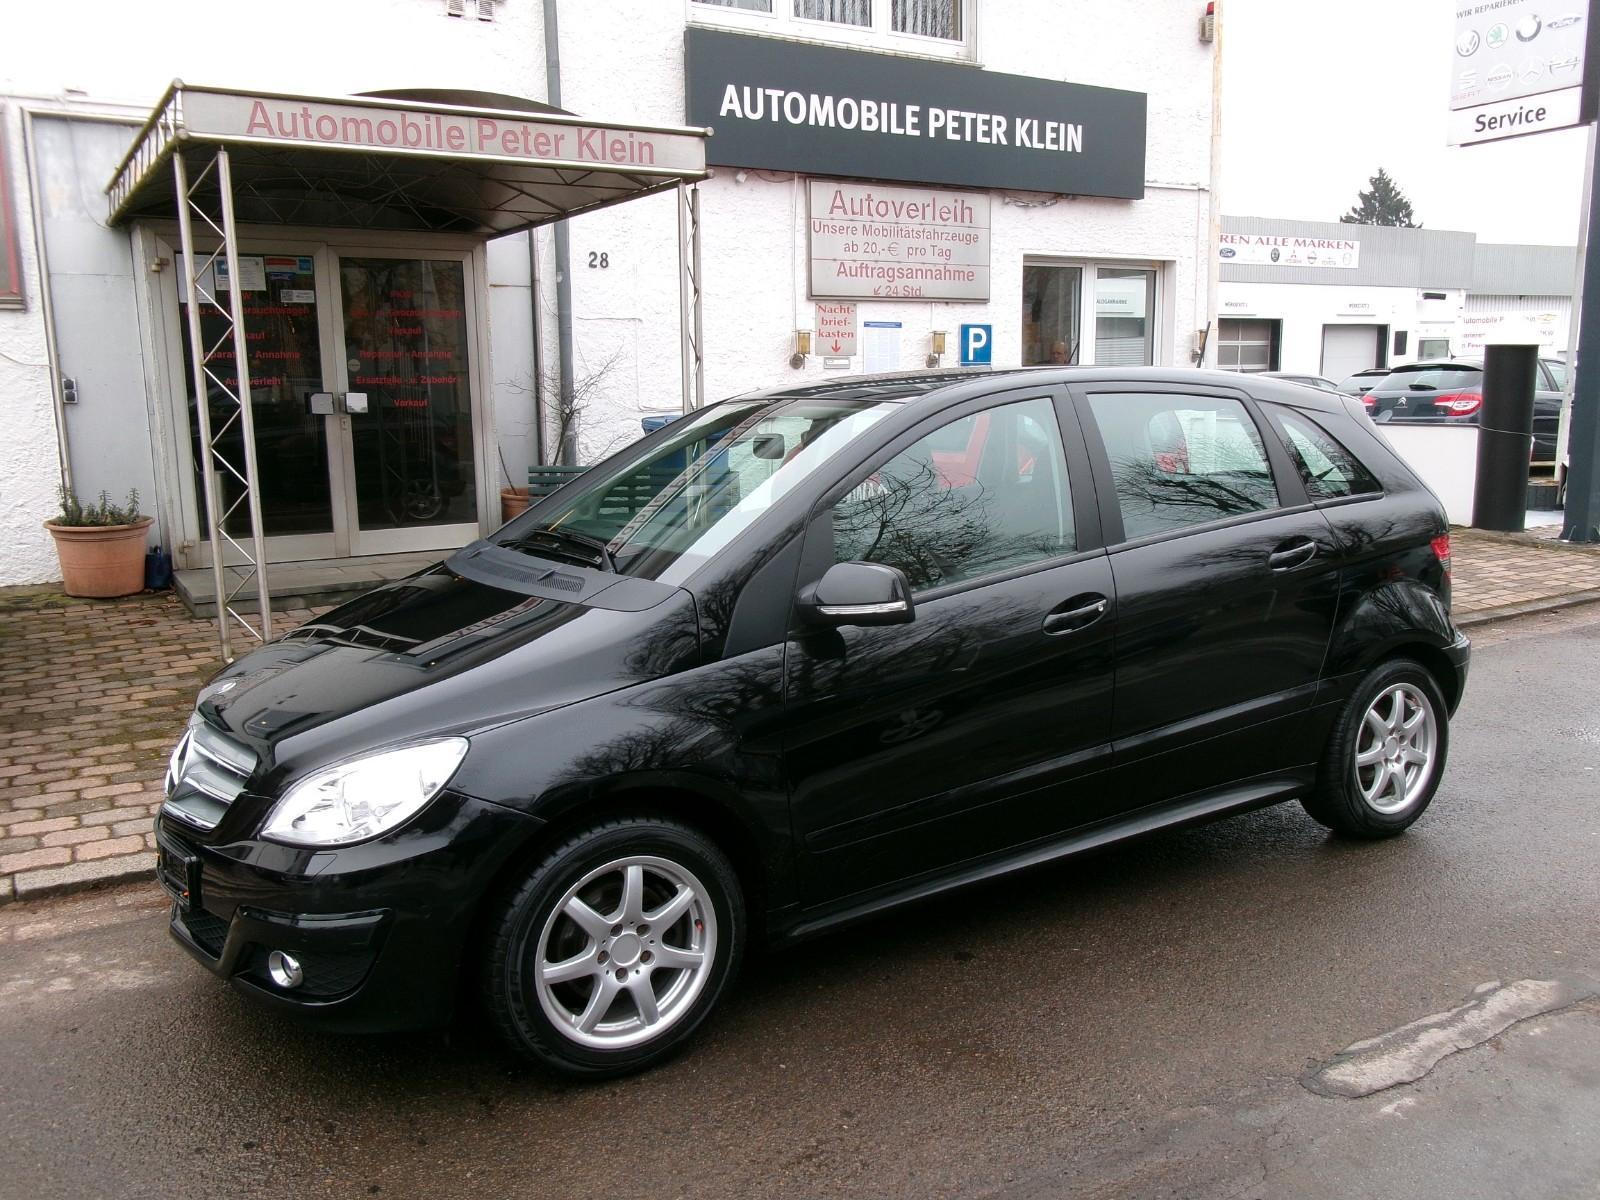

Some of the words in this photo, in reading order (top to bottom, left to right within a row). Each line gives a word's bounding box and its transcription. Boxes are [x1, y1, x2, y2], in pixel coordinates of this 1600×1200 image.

[719, 84, 921, 137] AUTOMOBILE
[928, 107, 1008, 146] PETER
[1015, 117, 1083, 153] KLEIN
[1474, 106, 1547, 132] Service
[246, 100, 465, 150] Automobile
[477, 119, 565, 157] Peter
[577, 127, 655, 165] Klein
[829, 190, 974, 224] Autoverleih
[813, 220, 858, 236] Unsere
[862, 224, 979, 246] Mobilitätsfahrzeuge
[843, 241, 859, 253] ab
[907, 245, 927, 259] pro
[930, 245, 952, 261] Tag
[1255, 237, 1289, 247] ALLE
[1293, 239, 1355, 250] MARKEN
[588, 251, 609, 269] 28
[836, 261, 975, 283] Auftragsannahme
[885, 286, 900, 297] 24
[902, 285, 925, 298] Std.
[817, 304, 854, 314] Nacht-
[821, 316, 852, 327] brief-
[817, 329, 854, 339] kasten
[968, 327, 987, 361] P
[394, 399, 428, 408] Verkauf
